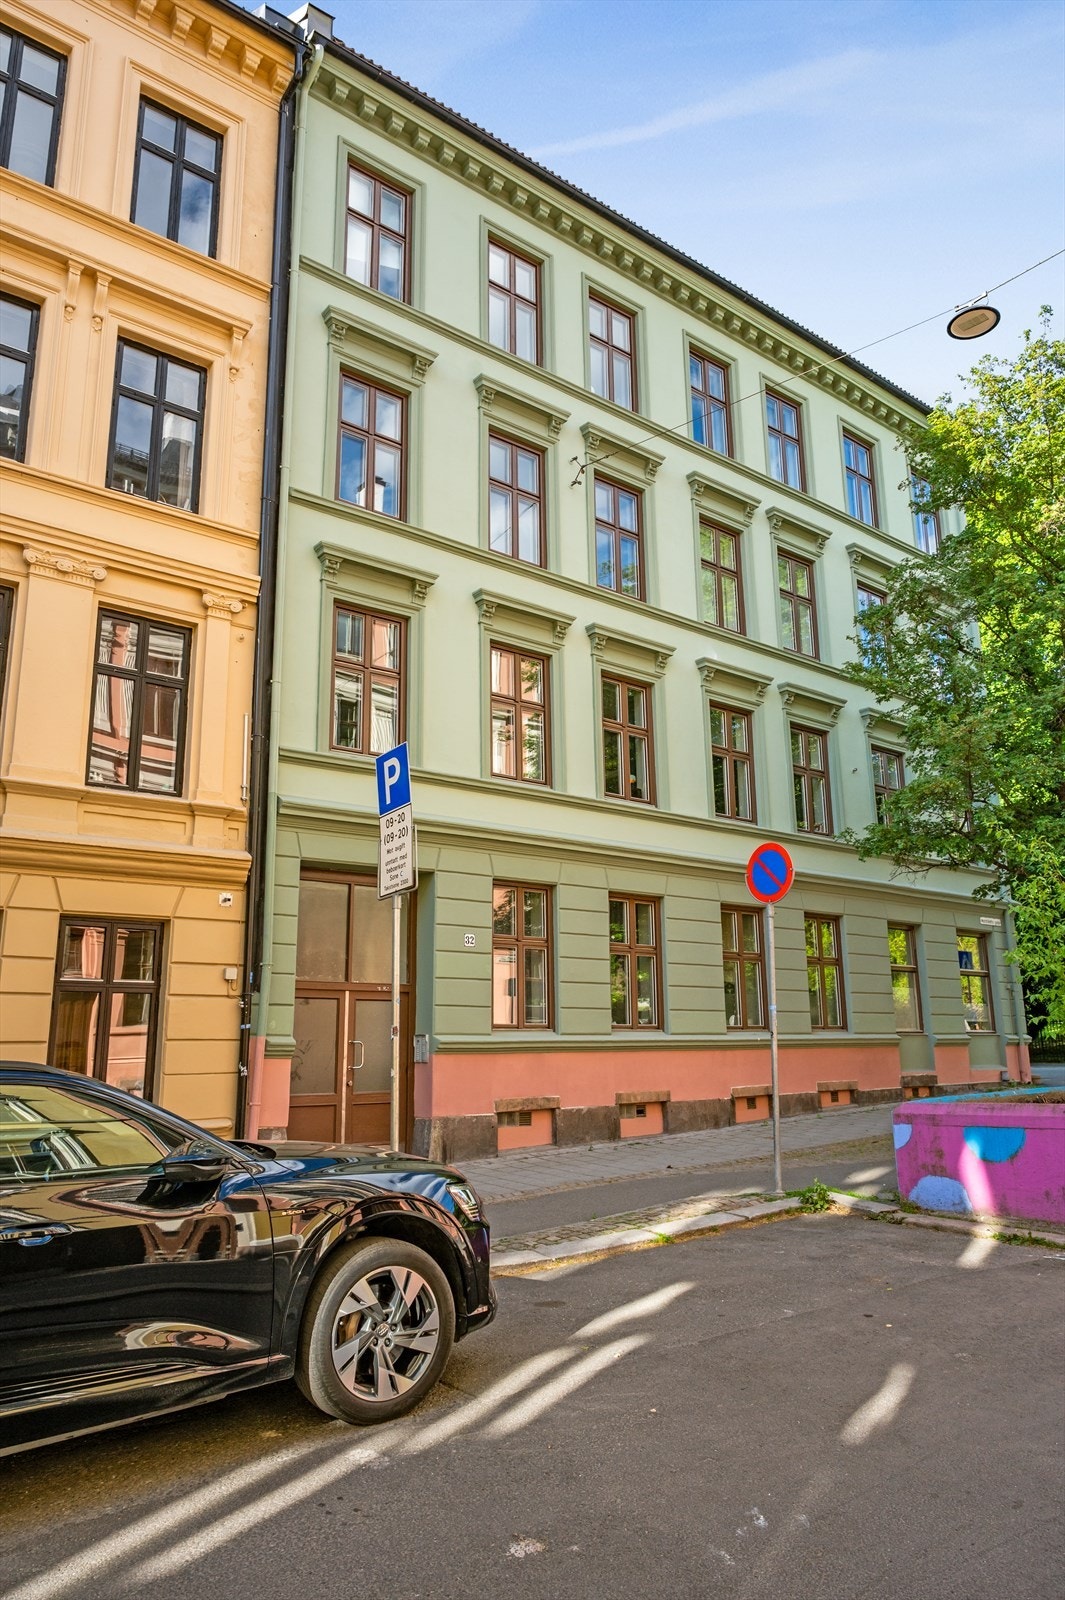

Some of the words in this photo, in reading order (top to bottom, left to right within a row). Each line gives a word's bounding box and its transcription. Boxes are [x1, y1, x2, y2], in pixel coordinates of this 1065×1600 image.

[384, 757, 400, 804] P
[395, 842, 406, 852] avgift
[399, 852, 407, 861] med
[390, 873, 398, 882] Sone
[465, 936, 474, 944] 32
